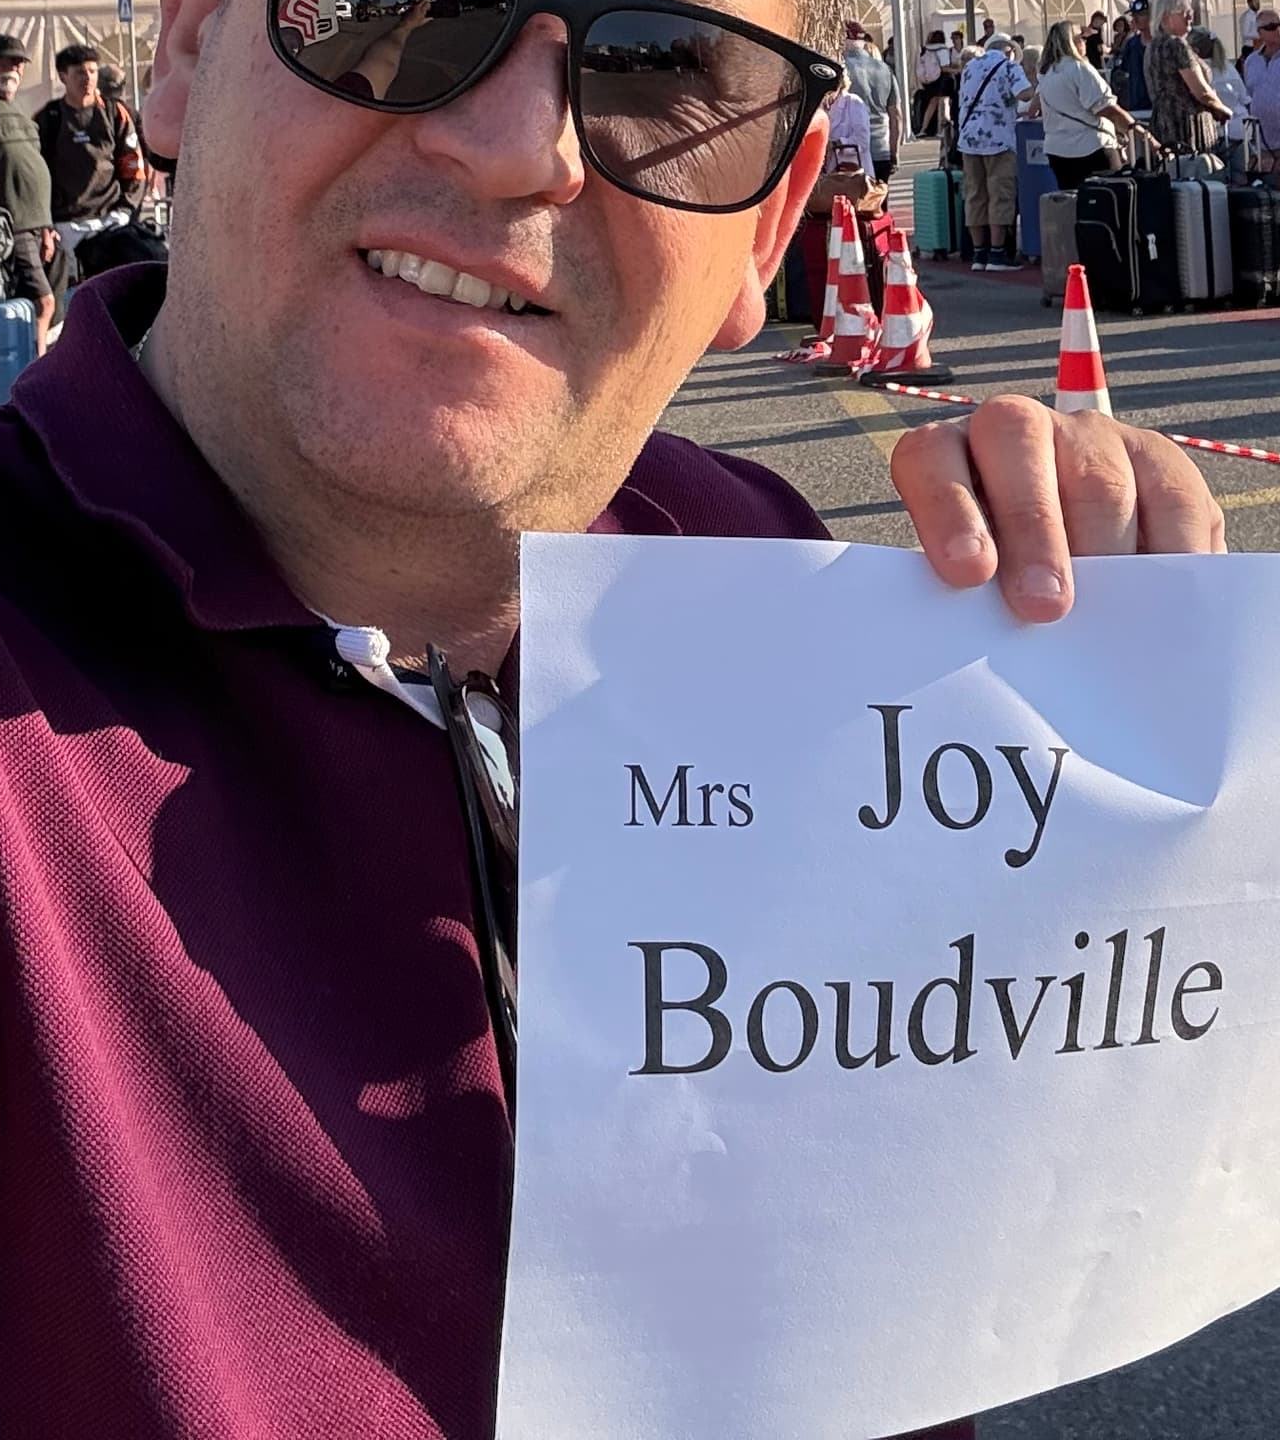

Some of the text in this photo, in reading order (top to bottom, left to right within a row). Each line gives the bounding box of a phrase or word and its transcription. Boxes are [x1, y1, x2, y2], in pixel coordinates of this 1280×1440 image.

[624, 705, 1069, 868] Mrs Joy
[628, 927, 1222, 1075] Boudville
